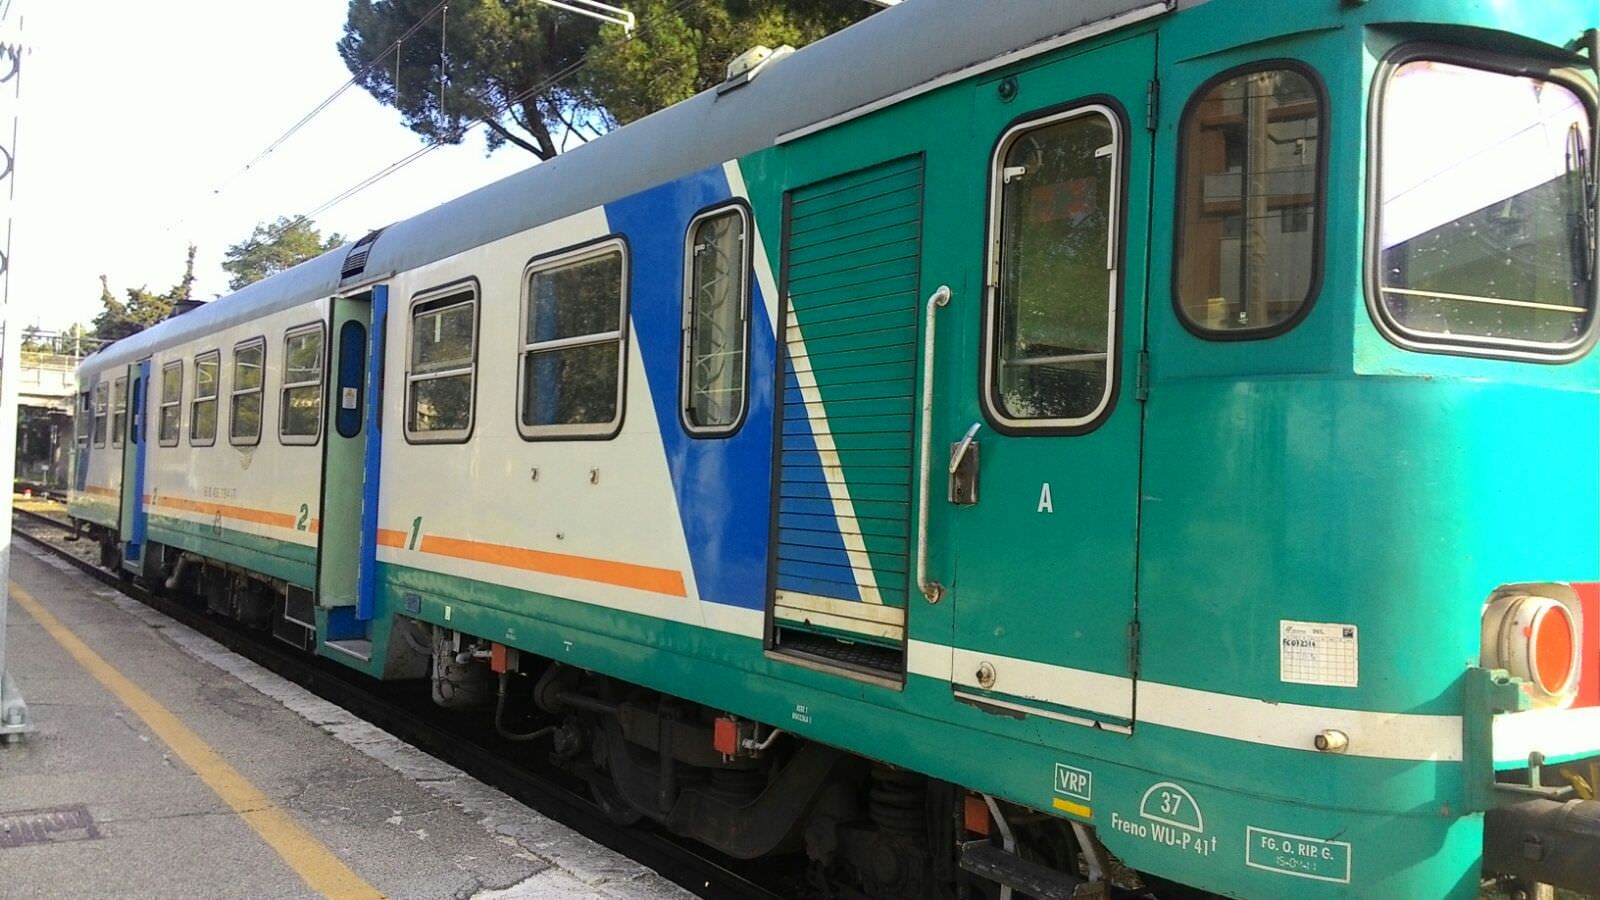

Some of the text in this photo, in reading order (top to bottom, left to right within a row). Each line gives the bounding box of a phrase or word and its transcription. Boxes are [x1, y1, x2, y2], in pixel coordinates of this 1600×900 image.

[1037, 482, 1053, 513] A
[297, 503, 309, 531] 2
[409, 516, 422, 551] 1
[1060, 769, 1087, 793] VRP
[1161, 791, 1182, 815] 37
[1111, 812, 1147, 838] Freno
[1151, 823, 1191, 849] WU-P
[1261, 836, 1279, 851] FG.
[1282, 840, 1295, 854] O.
[1321, 847, 1334, 860] G.
